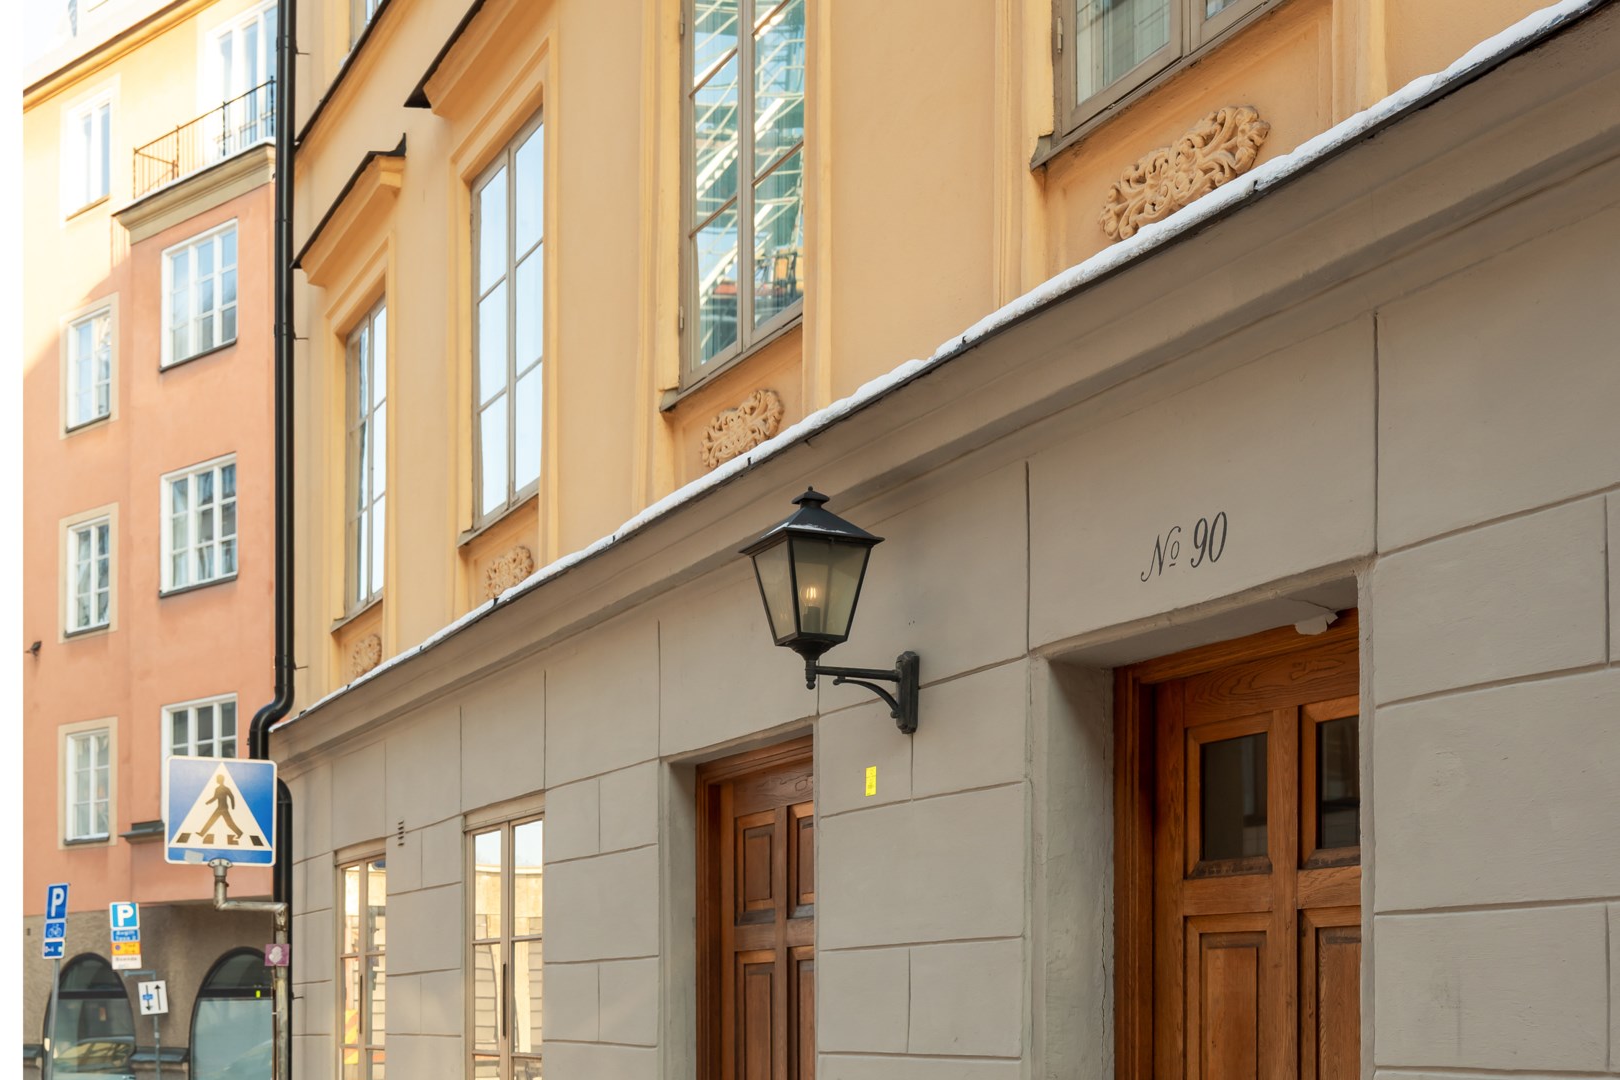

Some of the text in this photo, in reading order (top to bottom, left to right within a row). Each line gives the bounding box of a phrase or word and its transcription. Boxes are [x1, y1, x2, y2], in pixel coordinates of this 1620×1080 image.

[1190, 511, 1227, 568] 90
[51, 887, 65, 917] P
[117, 904, 134, 927] P
